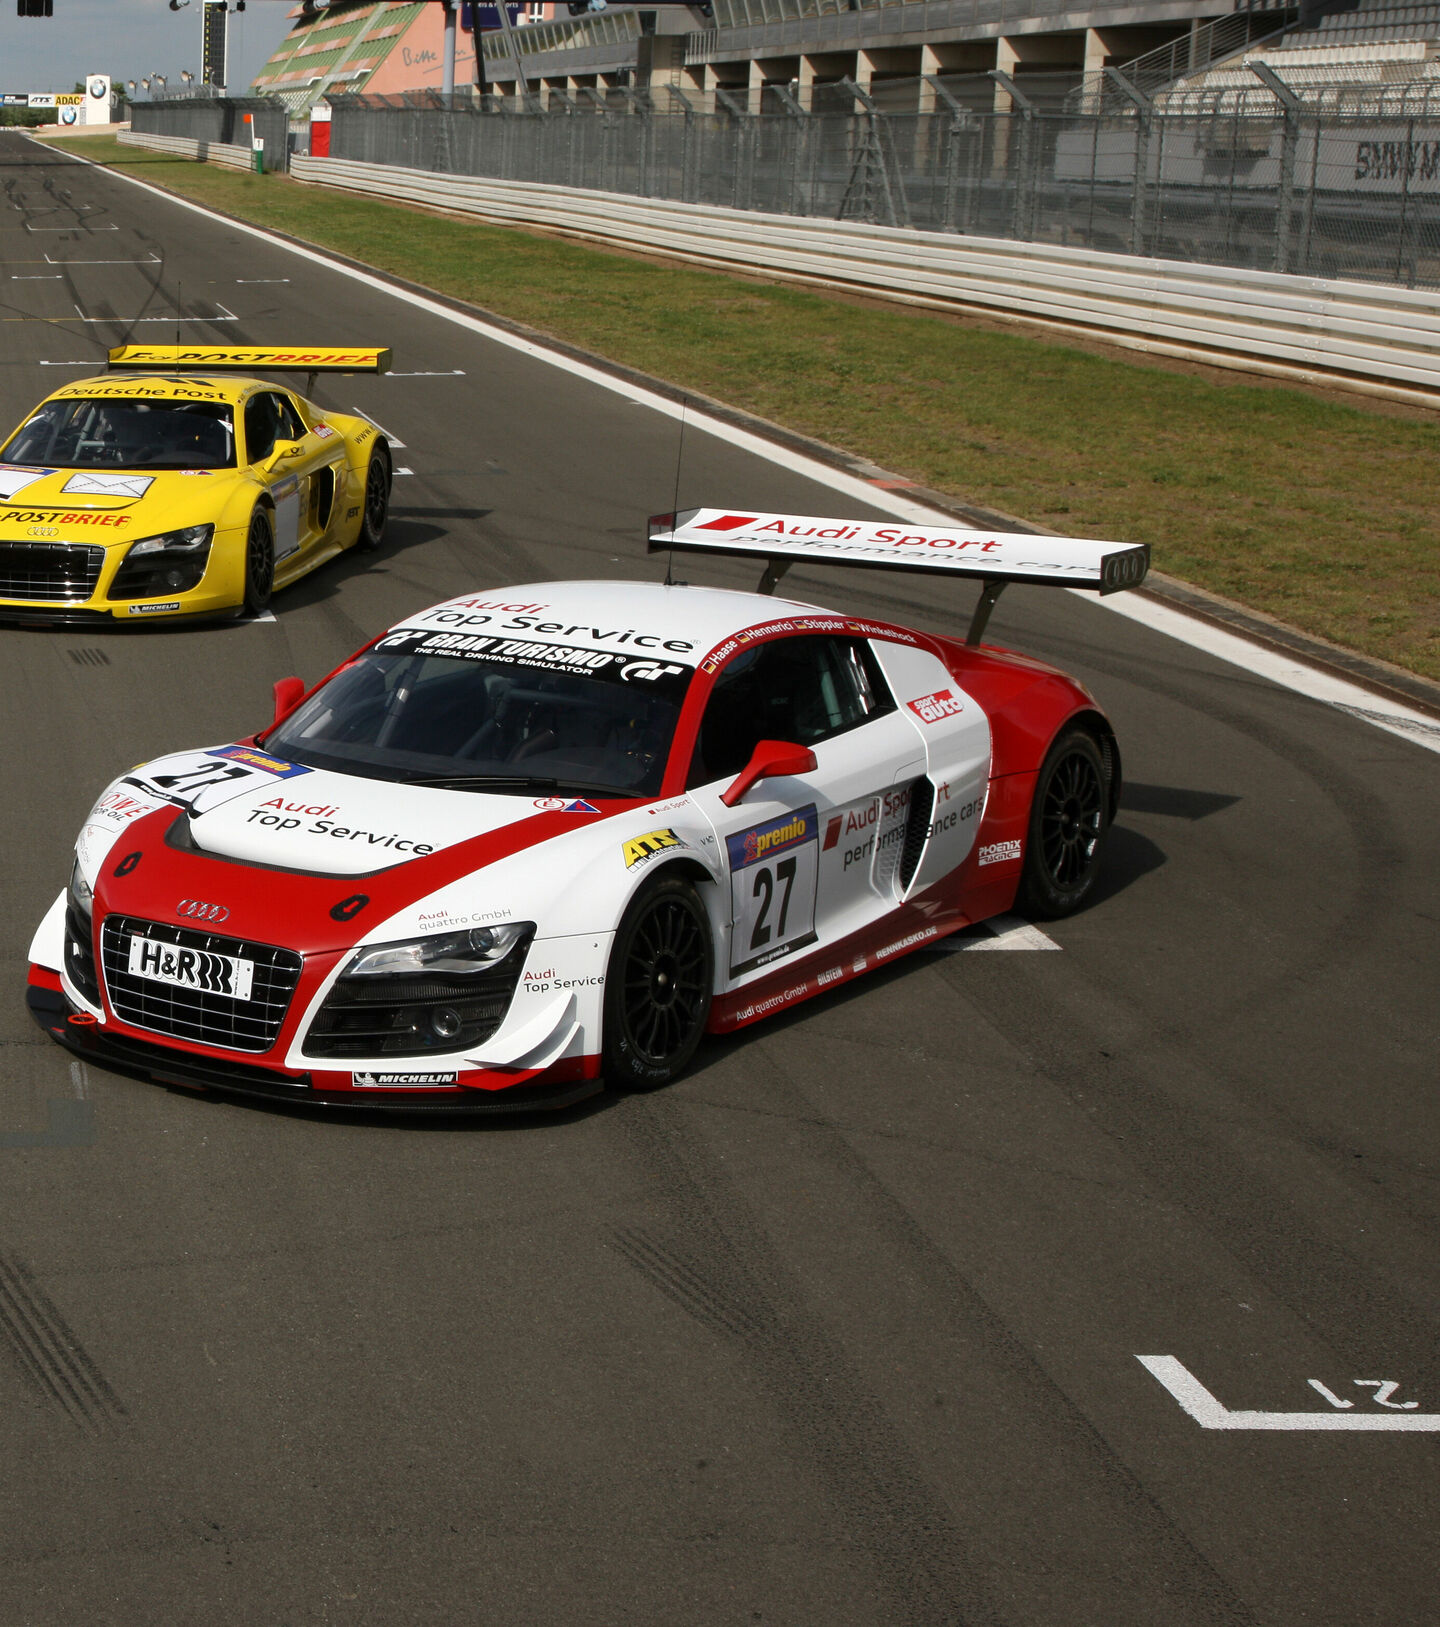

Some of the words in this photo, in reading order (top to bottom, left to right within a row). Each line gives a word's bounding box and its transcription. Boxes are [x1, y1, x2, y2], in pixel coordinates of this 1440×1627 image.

[55, 96, 80, 105] ADAC
[58, 387, 166, 397] Deutsche
[172, 388, 227, 401] Post
[730, 536, 1003, 563] performance
[754, 519, 862, 540] Audi
[866, 529, 1004, 553] Sport
[141, 603, 180, 612] MICHELIN
[448, 598, 553, 614] Audi
[419, 609, 501, 627] Top
[501, 615, 695, 654] Service
[710, 639, 738, 666] Haase
[746, 620, 794, 641] Hennerici
[804, 619, 844, 631] Stippler
[856, 623, 918, 645] Winkelhock
[413, 647, 434, 656] THE
[434, 649, 462, 660] REAL
[463, 652, 516, 665] DRIVING
[516, 658, 594, 676] SIMULATOR
[422, 633, 491, 653] GRAN
[491, 639, 610, 668] TURISMO
[914, 694, 936, 710] sport
[919, 697, 964, 722] auto
[236, 752, 292, 772] premio
[149, 760, 254, 793] 27
[260, 797, 340, 817] Audi
[845, 802, 881, 836] Audi
[960, 794, 984, 820] cars
[246, 809, 301, 831] Top
[307, 820, 434, 856] Service
[756, 816, 806, 858] premio
[624, 829, 680, 868] ATS
[418, 910, 449, 921] Audi
[749, 856, 797, 951] 27
[419, 915, 468, 931] quattro
[471, 908, 512, 923] GmbH
[875, 925, 938, 960] RENNKASKO.DE
[140, 940, 215, 988] H&R
[523, 968, 556, 982] Audi
[816, 966, 844, 986] BILSTEIN
[523, 982, 549, 993] Top
[553, 975, 605, 990] Service
[736, 1003, 756, 1022] Audi
[755, 995, 784, 1014] quattro
[784, 983, 808, 1001] GmbH
[378, 1074, 454, 1083] MICHELIN
[1307, 1378, 1419, 1409] 21
